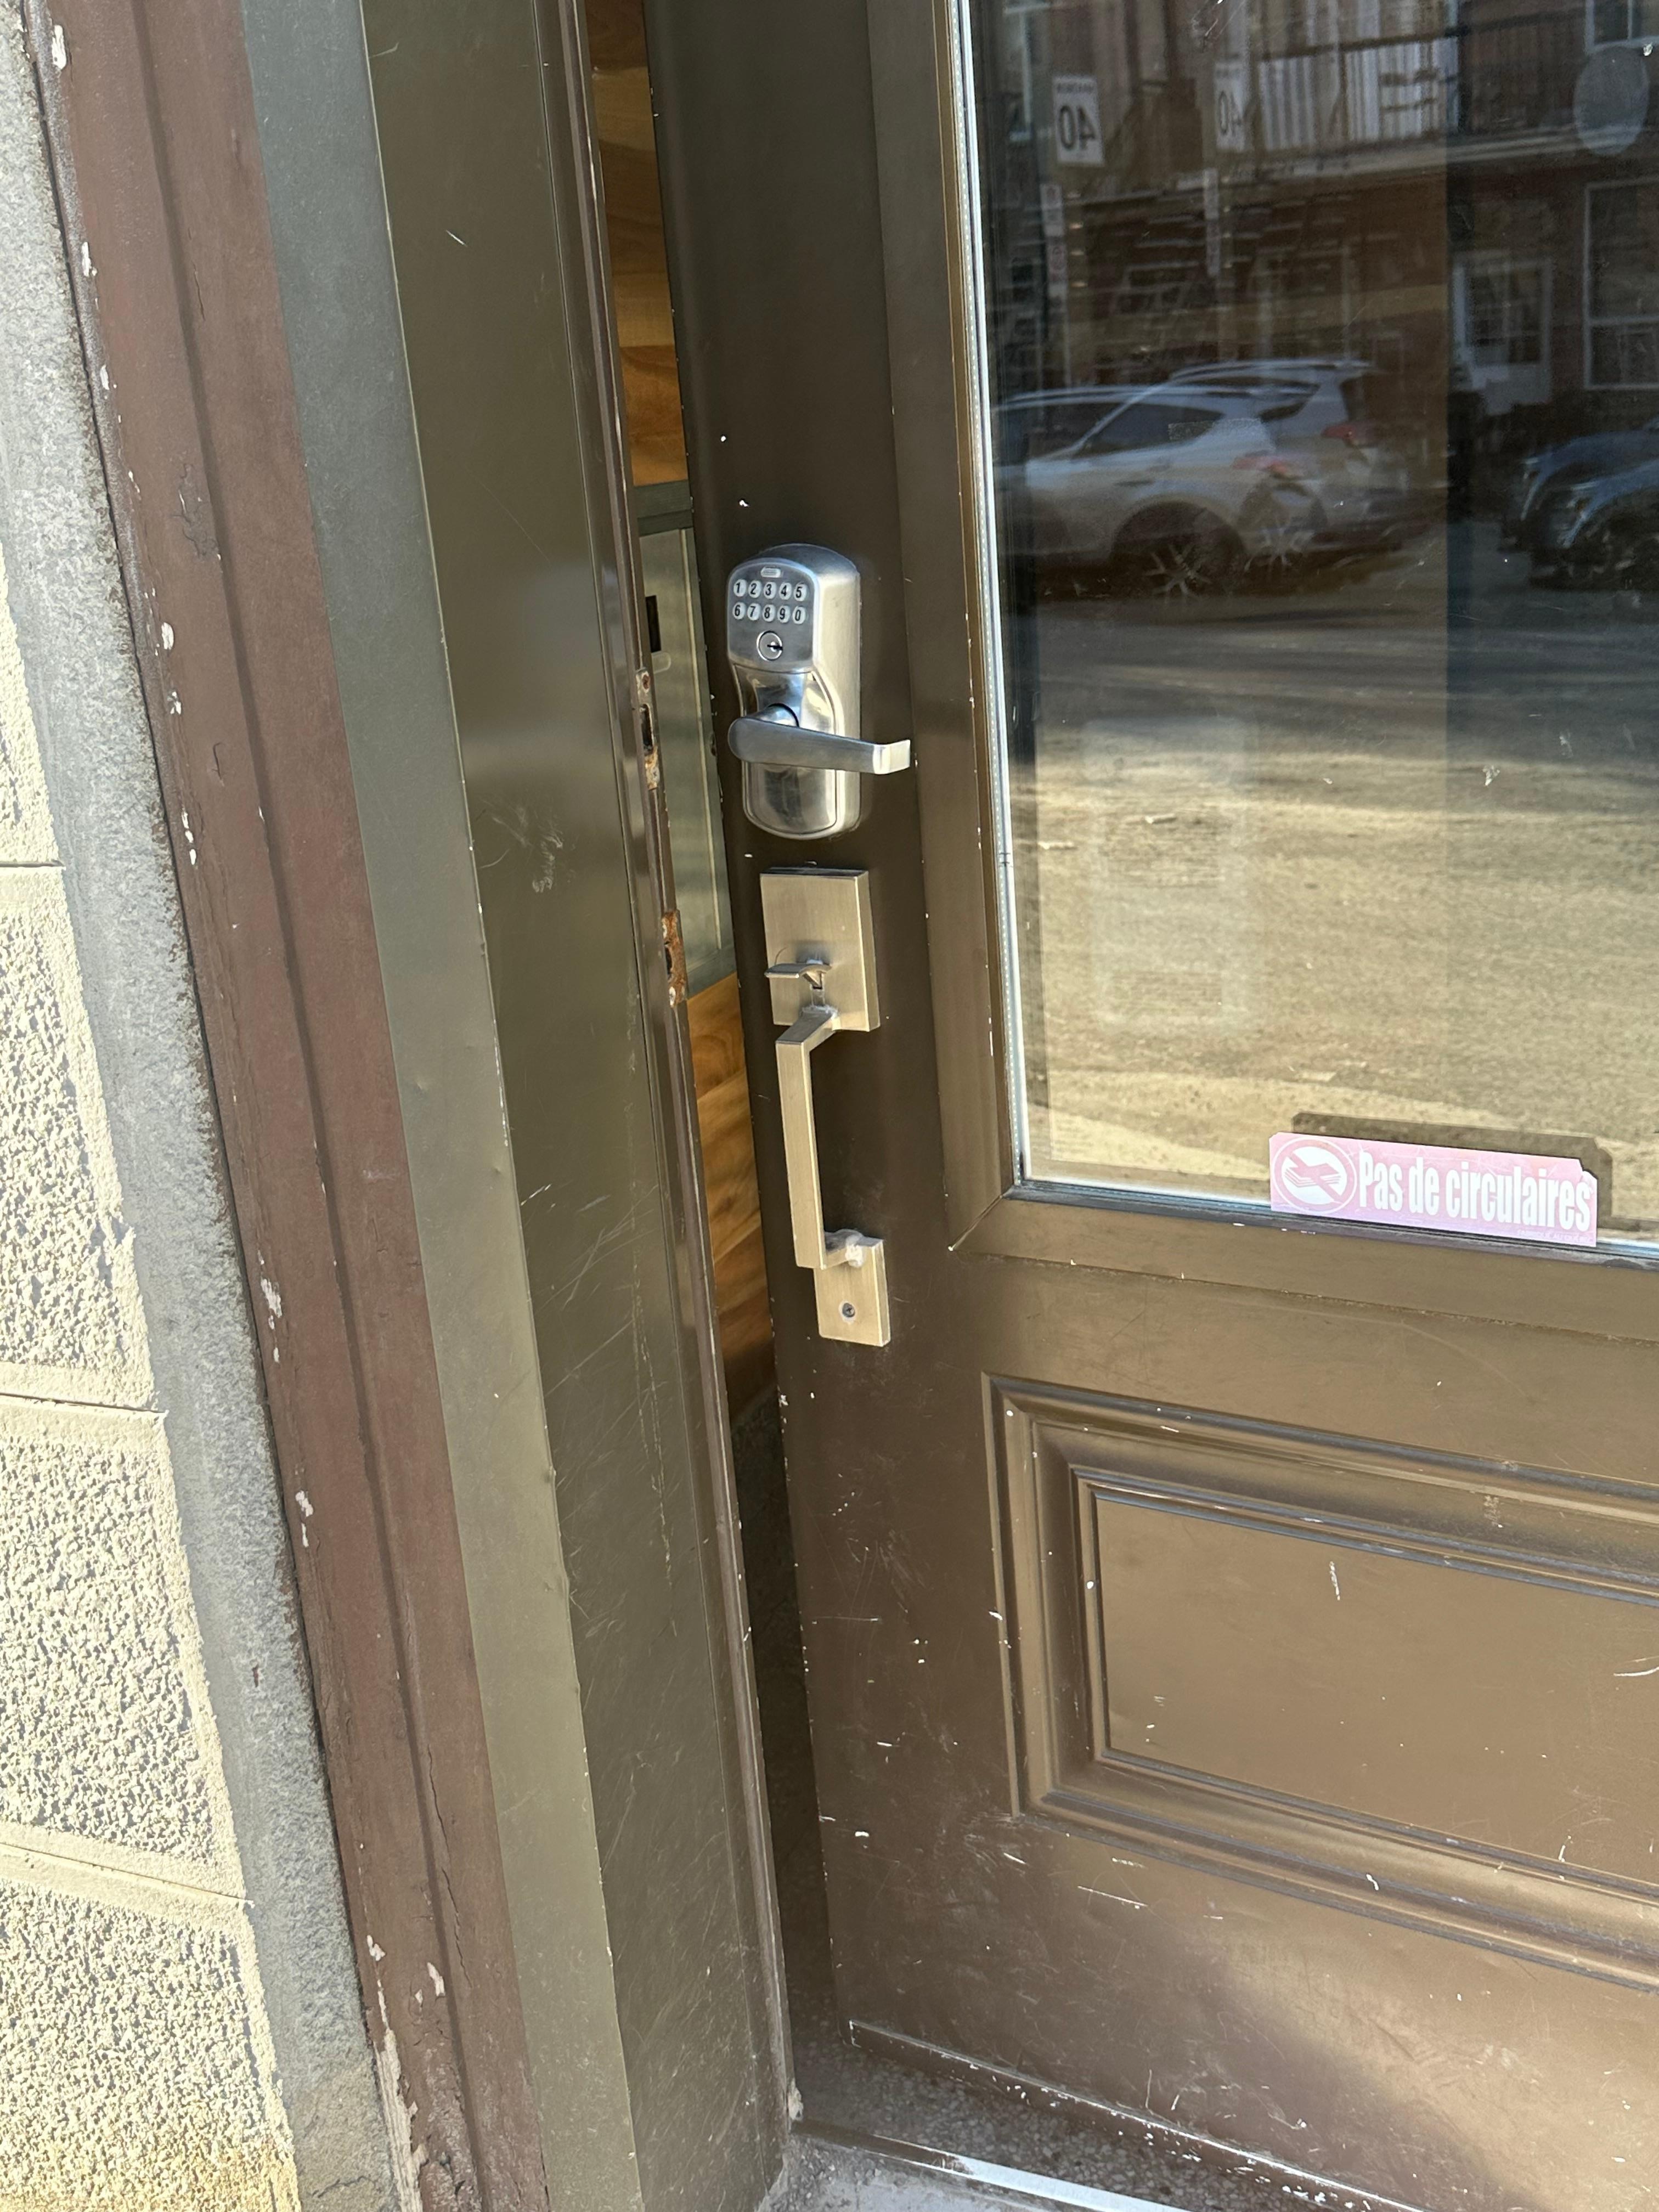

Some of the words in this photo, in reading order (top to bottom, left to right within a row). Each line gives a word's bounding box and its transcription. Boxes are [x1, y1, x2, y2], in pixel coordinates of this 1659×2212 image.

[736, 582, 741, 593] 1
[750, 583, 757, 595] 2
[765, 584, 772, 596] 3
[781, 585, 787, 597] 4
[795, 586, 803, 598] 5
[735, 605, 741, 617] 6
[750, 606, 756, 617] 7
[764, 607, 770, 619] 8
[779, 608, 785, 620] 9
[795, 610, 801, 621] 0
[1358, 1150, 1403, 1211] Pas
[1408, 1157, 1440, 1216] de
[1446, 1161, 1593, 1232] circulaires
